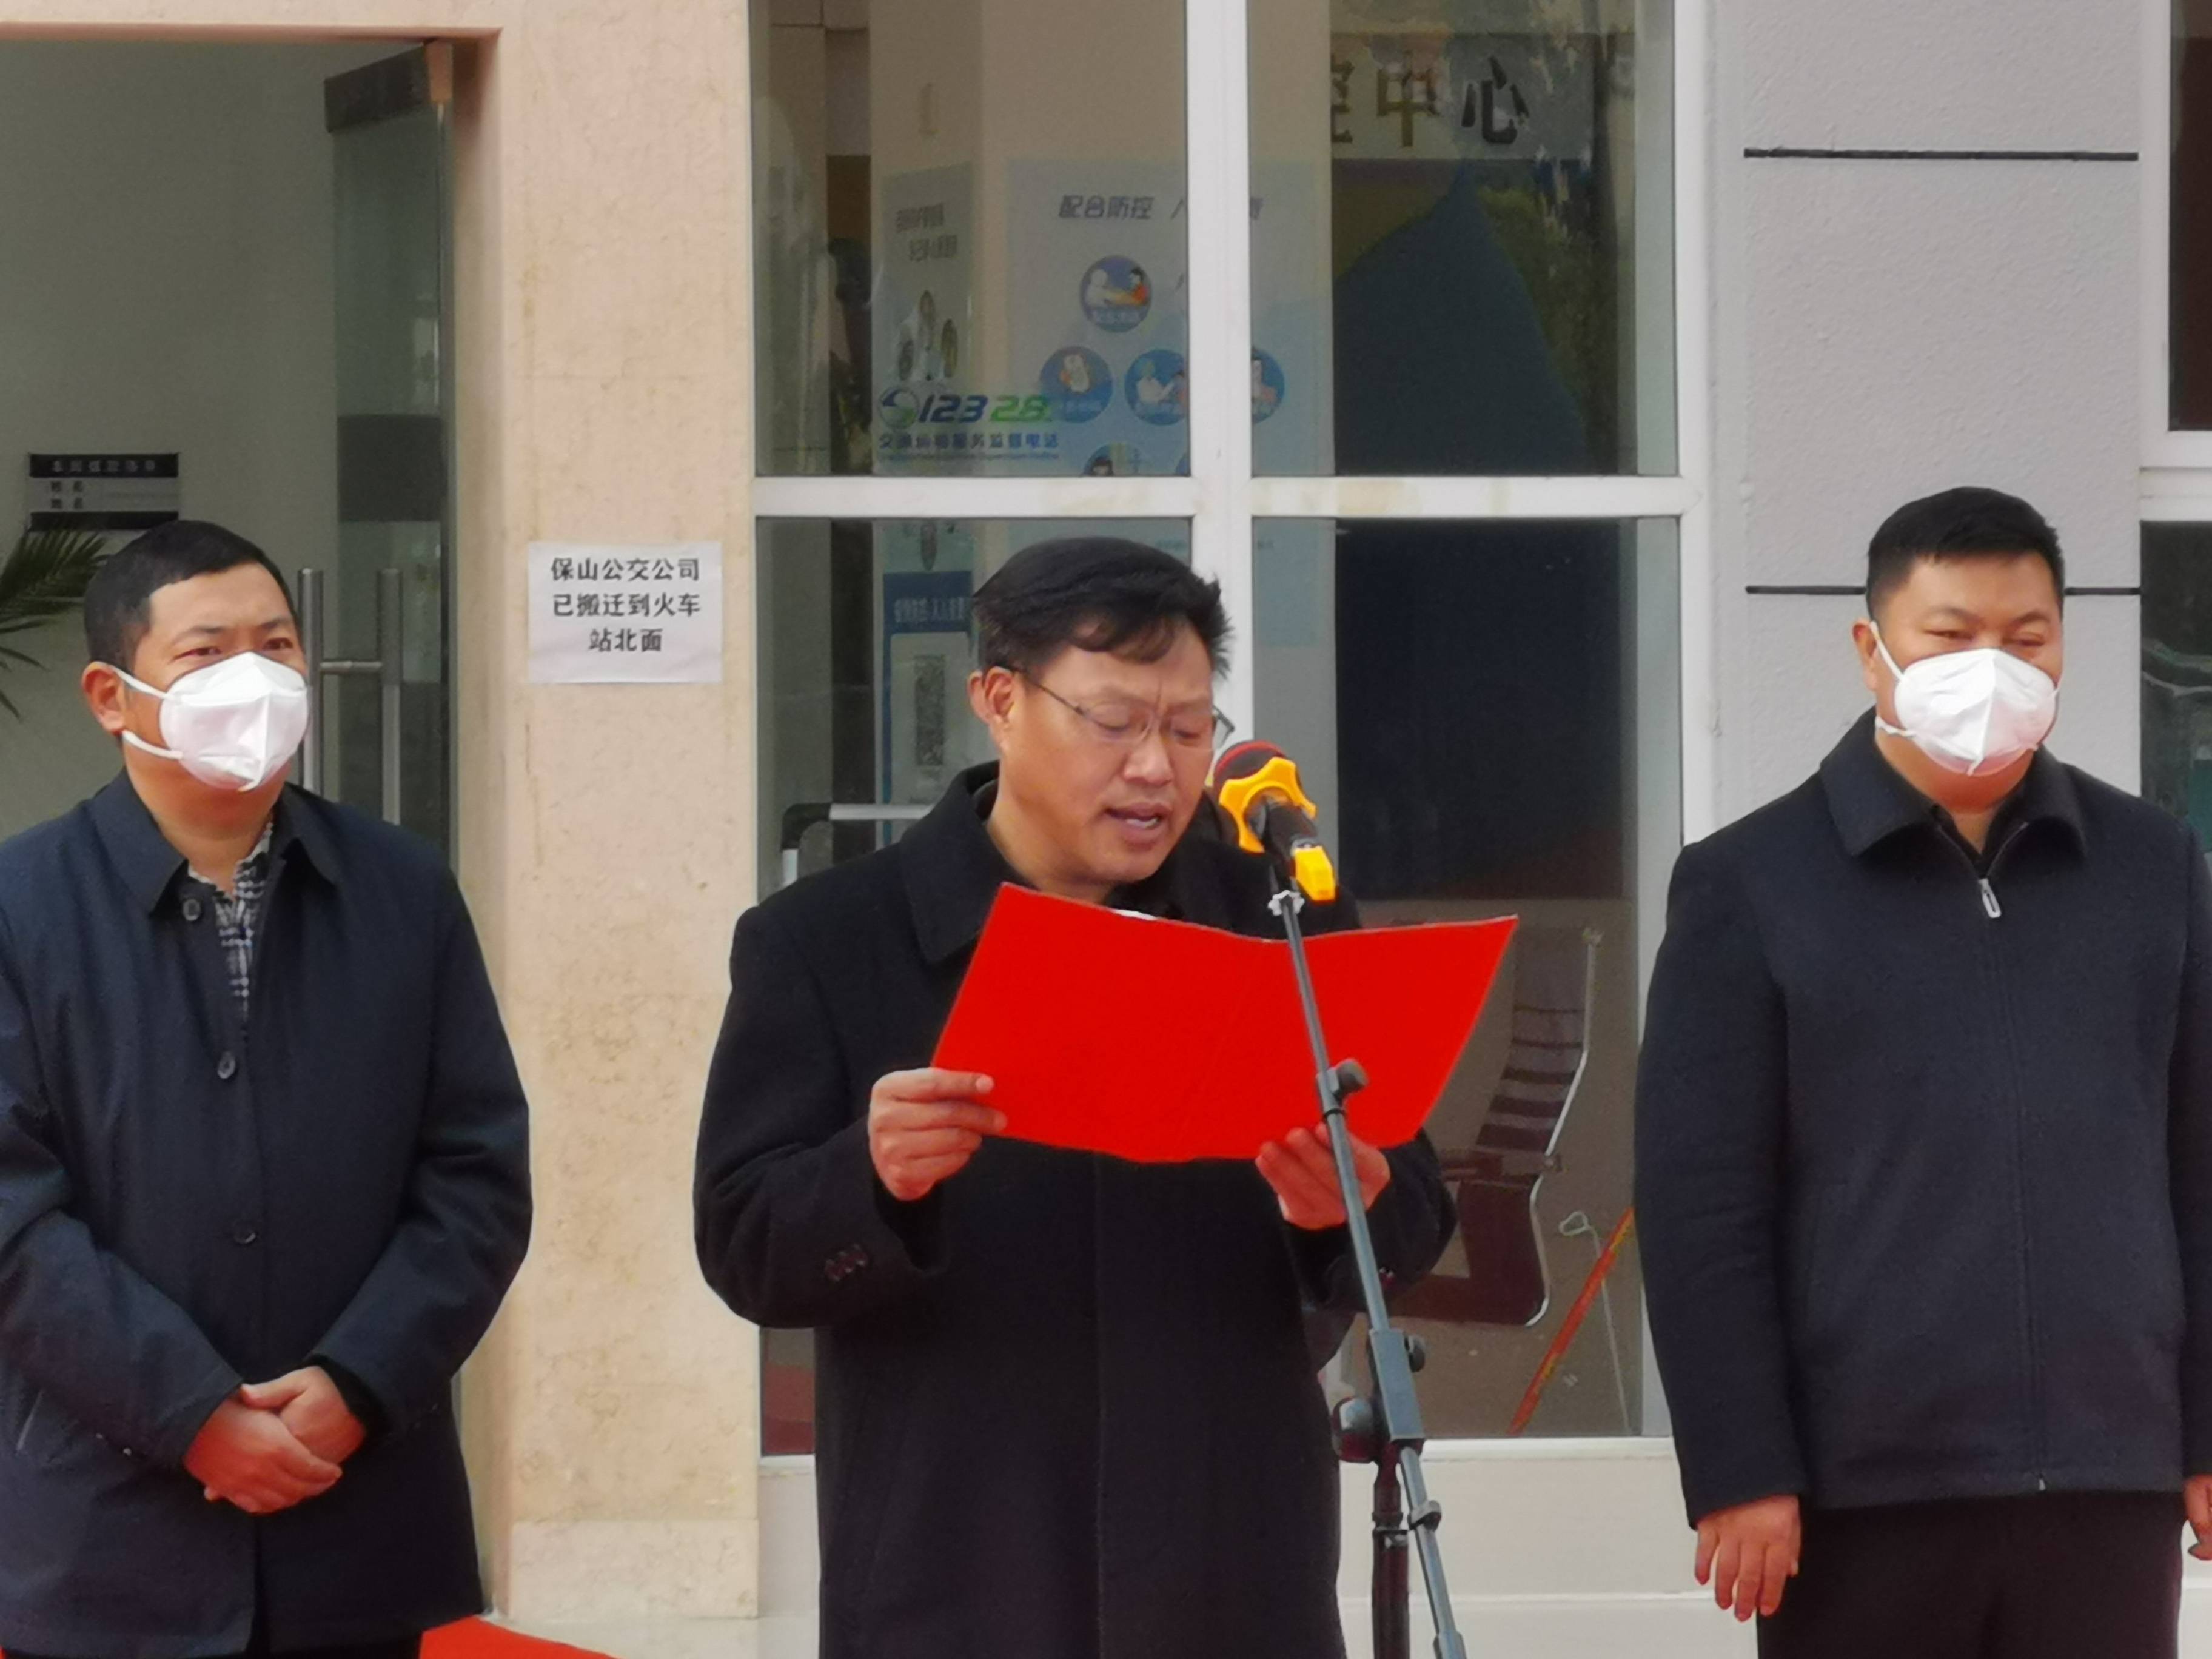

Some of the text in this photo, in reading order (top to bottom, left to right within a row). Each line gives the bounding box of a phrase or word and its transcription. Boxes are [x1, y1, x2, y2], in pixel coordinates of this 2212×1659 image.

[551, 557, 700, 582] 保山公交公司
[552, 592, 700, 617] 已搬迁到火车
[588, 628, 663, 653] 站北面
